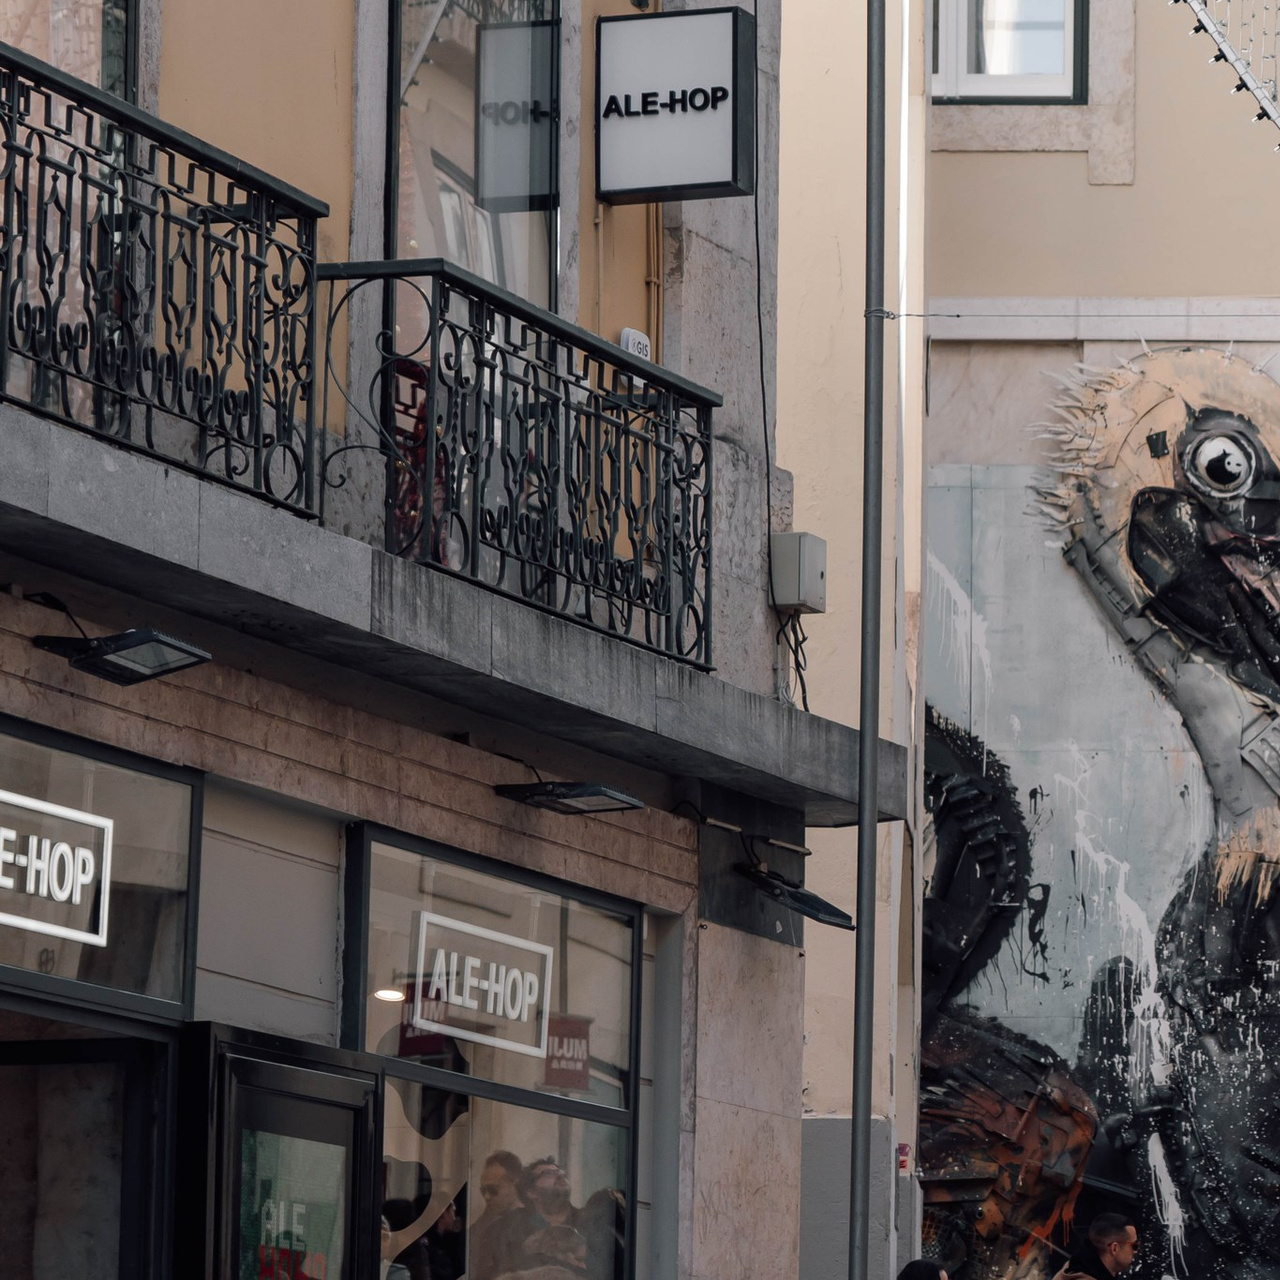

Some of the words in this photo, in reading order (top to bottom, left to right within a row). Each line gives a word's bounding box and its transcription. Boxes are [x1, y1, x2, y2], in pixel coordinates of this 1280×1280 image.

[602, 86, 729, 118] ALE-HOP
[0, 826, 95, 905] E-HOP
[428, 948, 539, 1022] ALE-HOP
[261, 1199, 306, 1251] ALE
